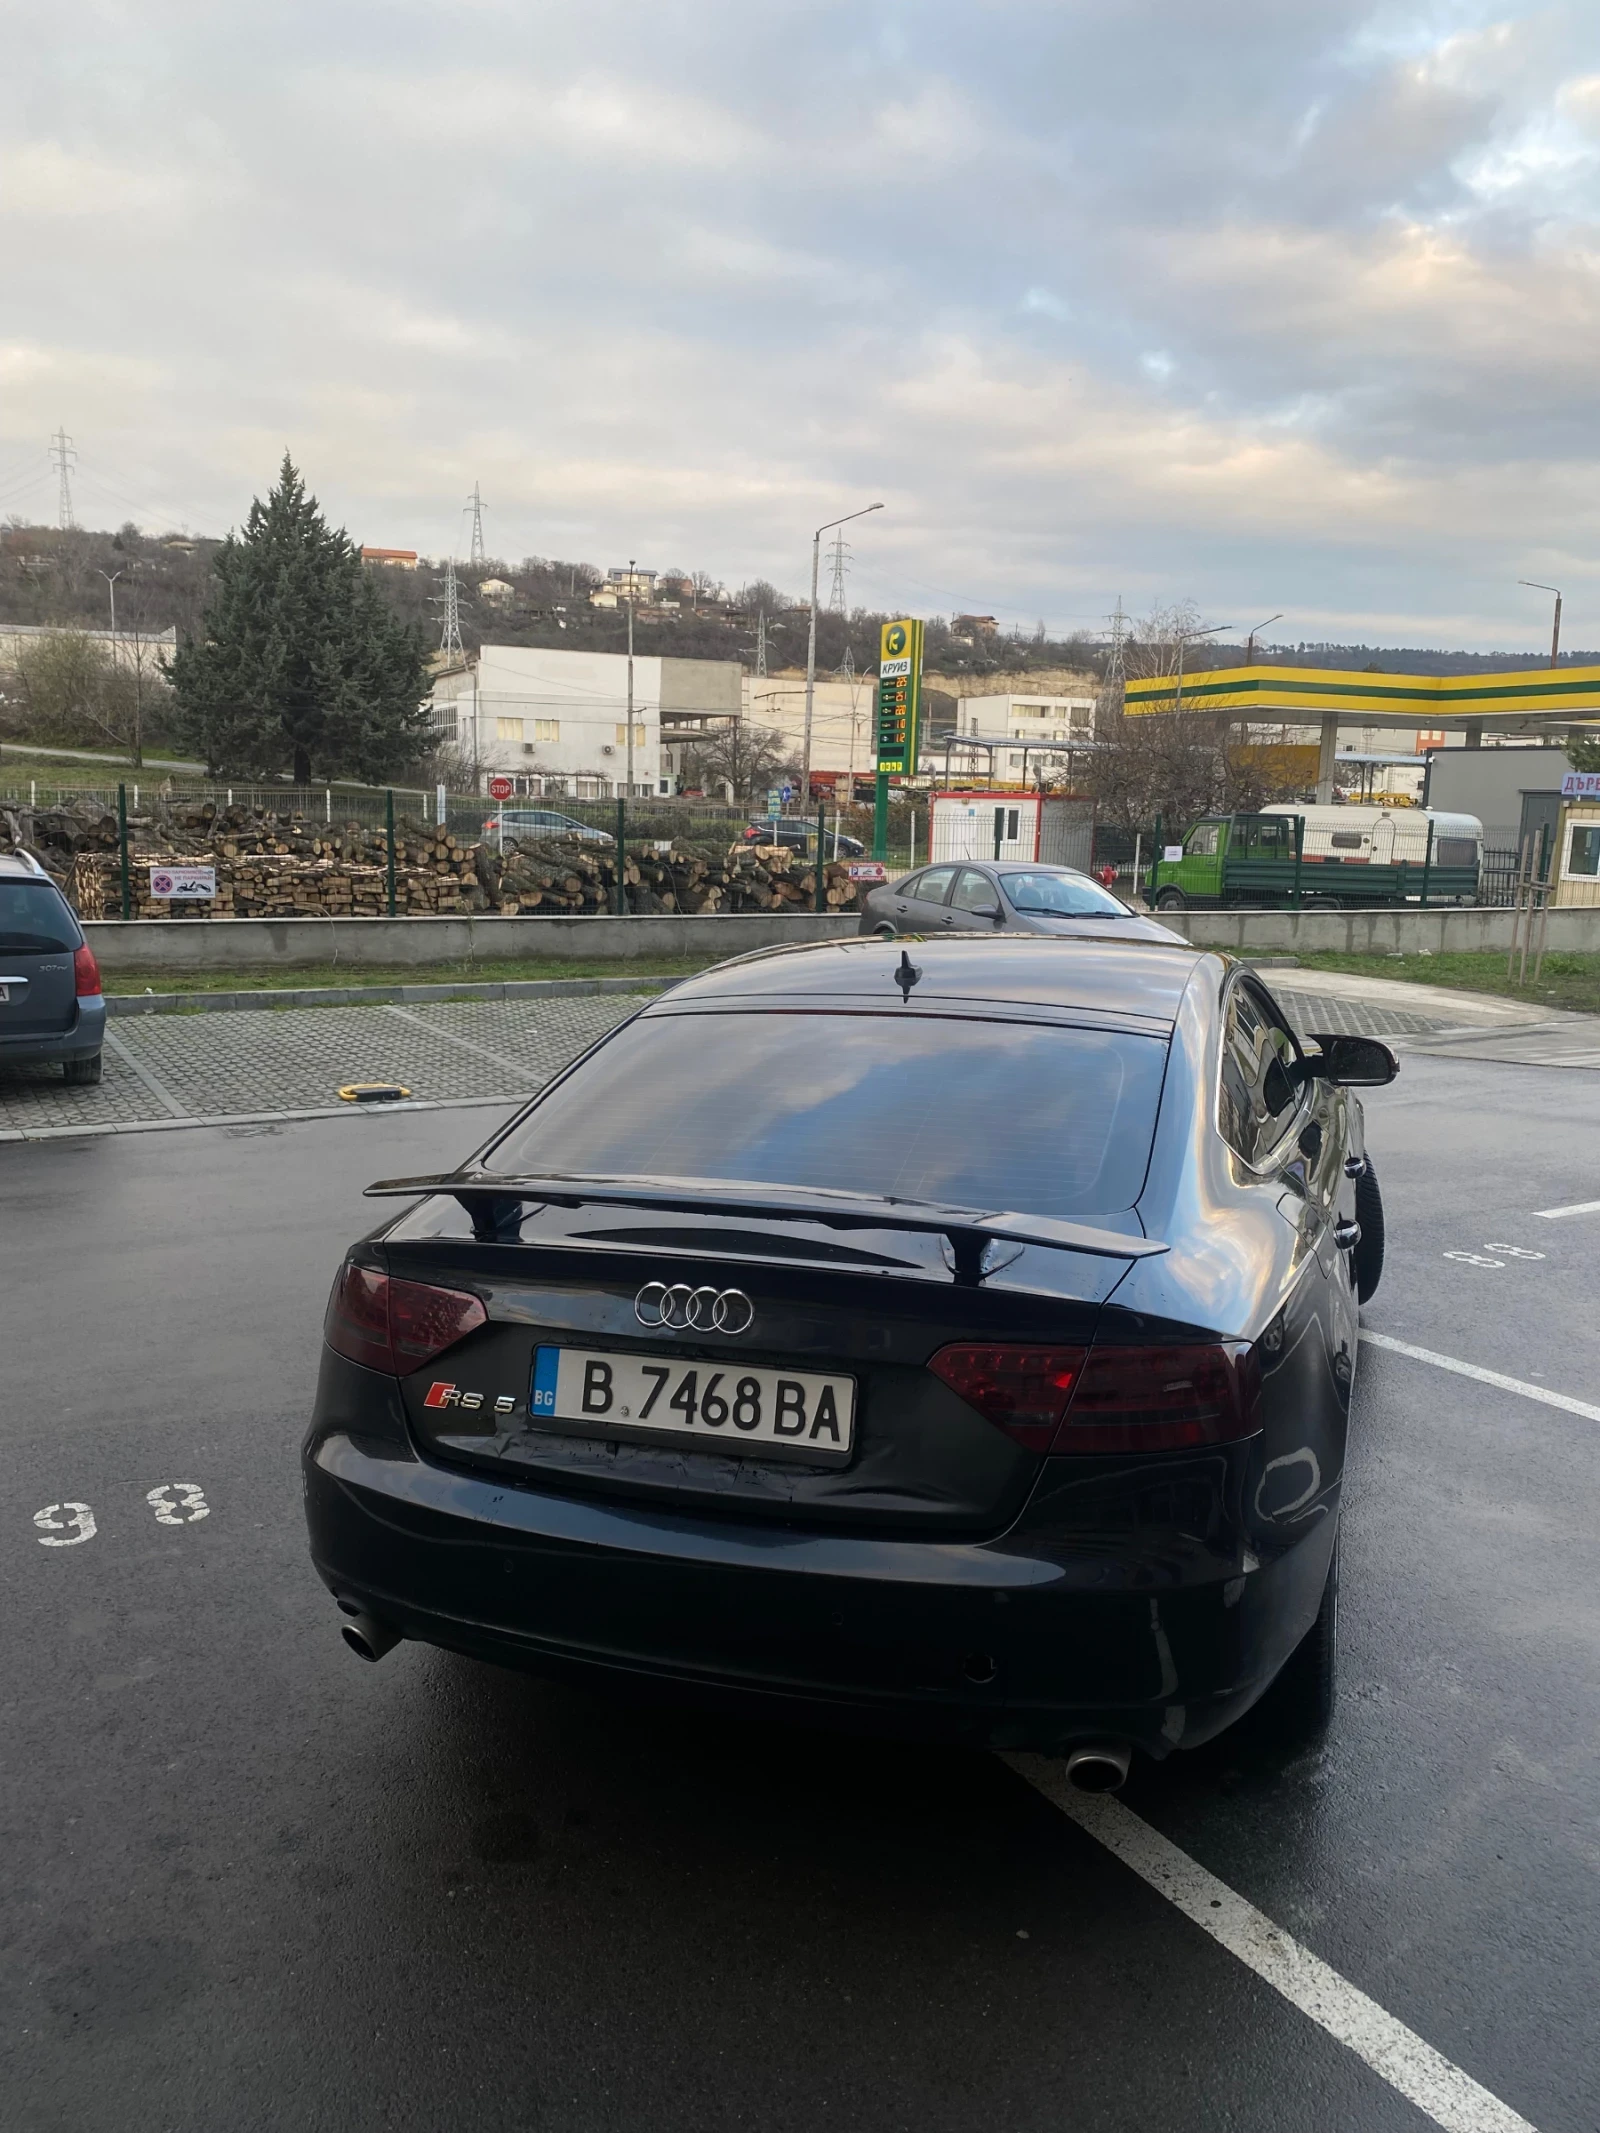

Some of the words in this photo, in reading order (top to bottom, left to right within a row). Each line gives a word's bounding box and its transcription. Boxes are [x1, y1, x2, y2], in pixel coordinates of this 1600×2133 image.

[882, 661, 908, 674] КРУИЗ
[491, 785, 510, 794] STOP
[438, 1388, 485, 1410] RS
[493, 1396, 517, 1414] 5
[534, 1389, 554, 1406] BG
[638, 1365, 763, 1431] 7468
